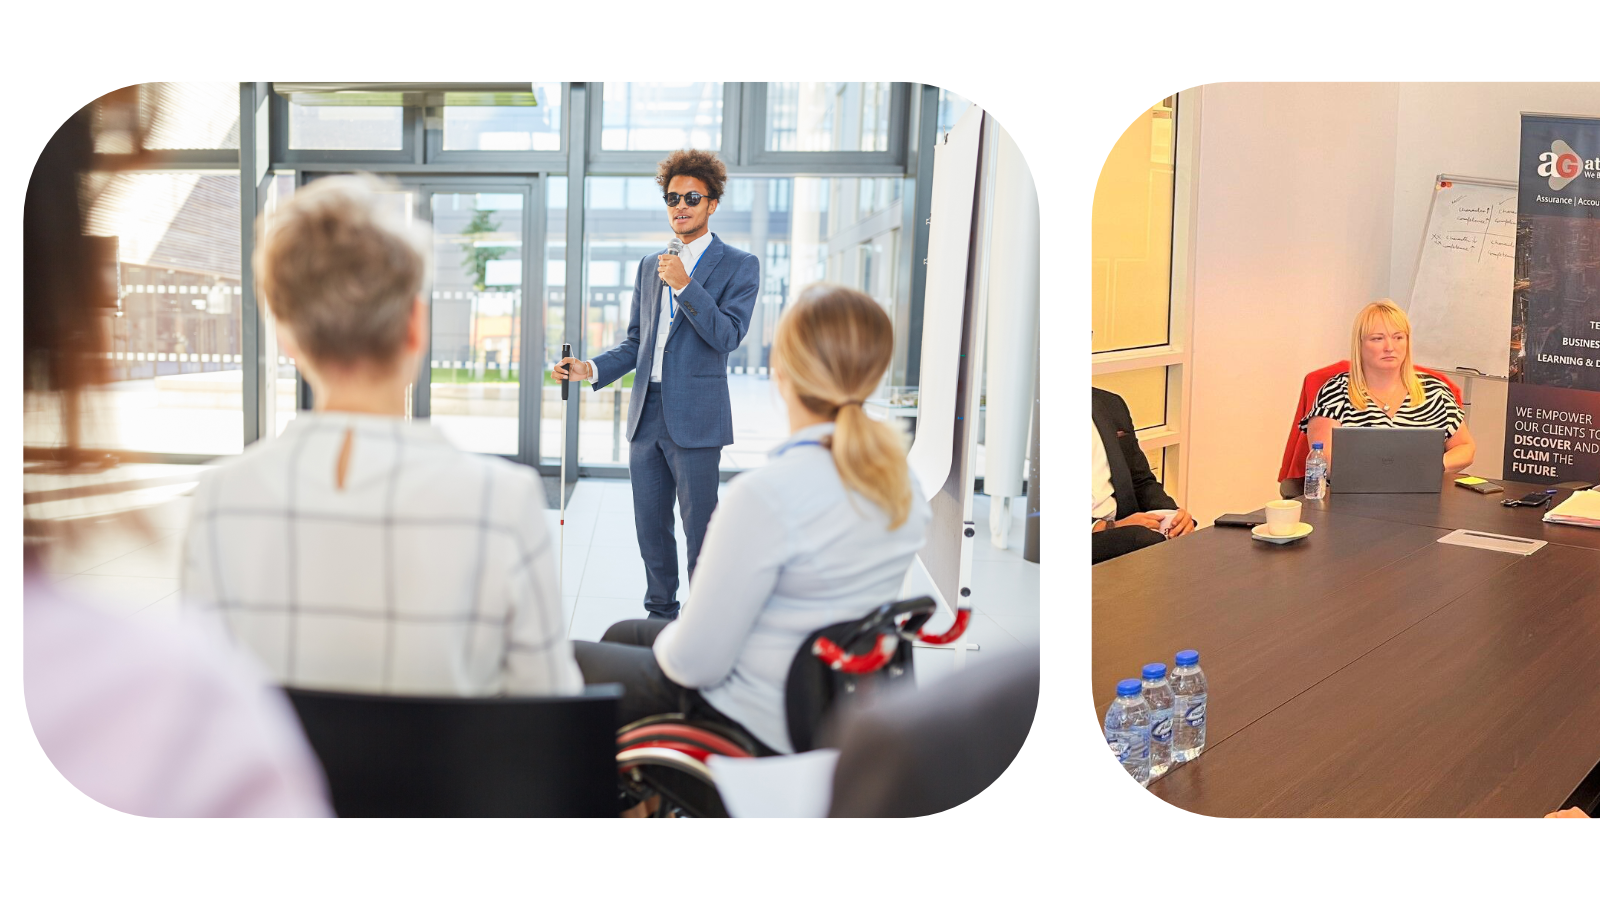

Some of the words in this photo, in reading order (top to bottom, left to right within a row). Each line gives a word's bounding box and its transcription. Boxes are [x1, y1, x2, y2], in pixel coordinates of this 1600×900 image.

[1584, 171, 1596, 179] We
[1536, 194, 1573, 205] Assurance
[1537, 353, 1584, 366] LEARNING
[1585, 358, 1593, 367] &
[1515, 406, 1533, 418] WE
[1536, 408, 1593, 425] EMPOWER
[1515, 420, 1539, 433] OUR
[1542, 423, 1586, 438] CLIENTS
[1514, 434, 1571, 450] DISCOVER
[1574, 442, 1600, 454] AND
[1513, 448, 1550, 462] CLAIM
[1553, 452, 1574, 465] THE
[1512, 462, 1559, 478] FUTURE.
